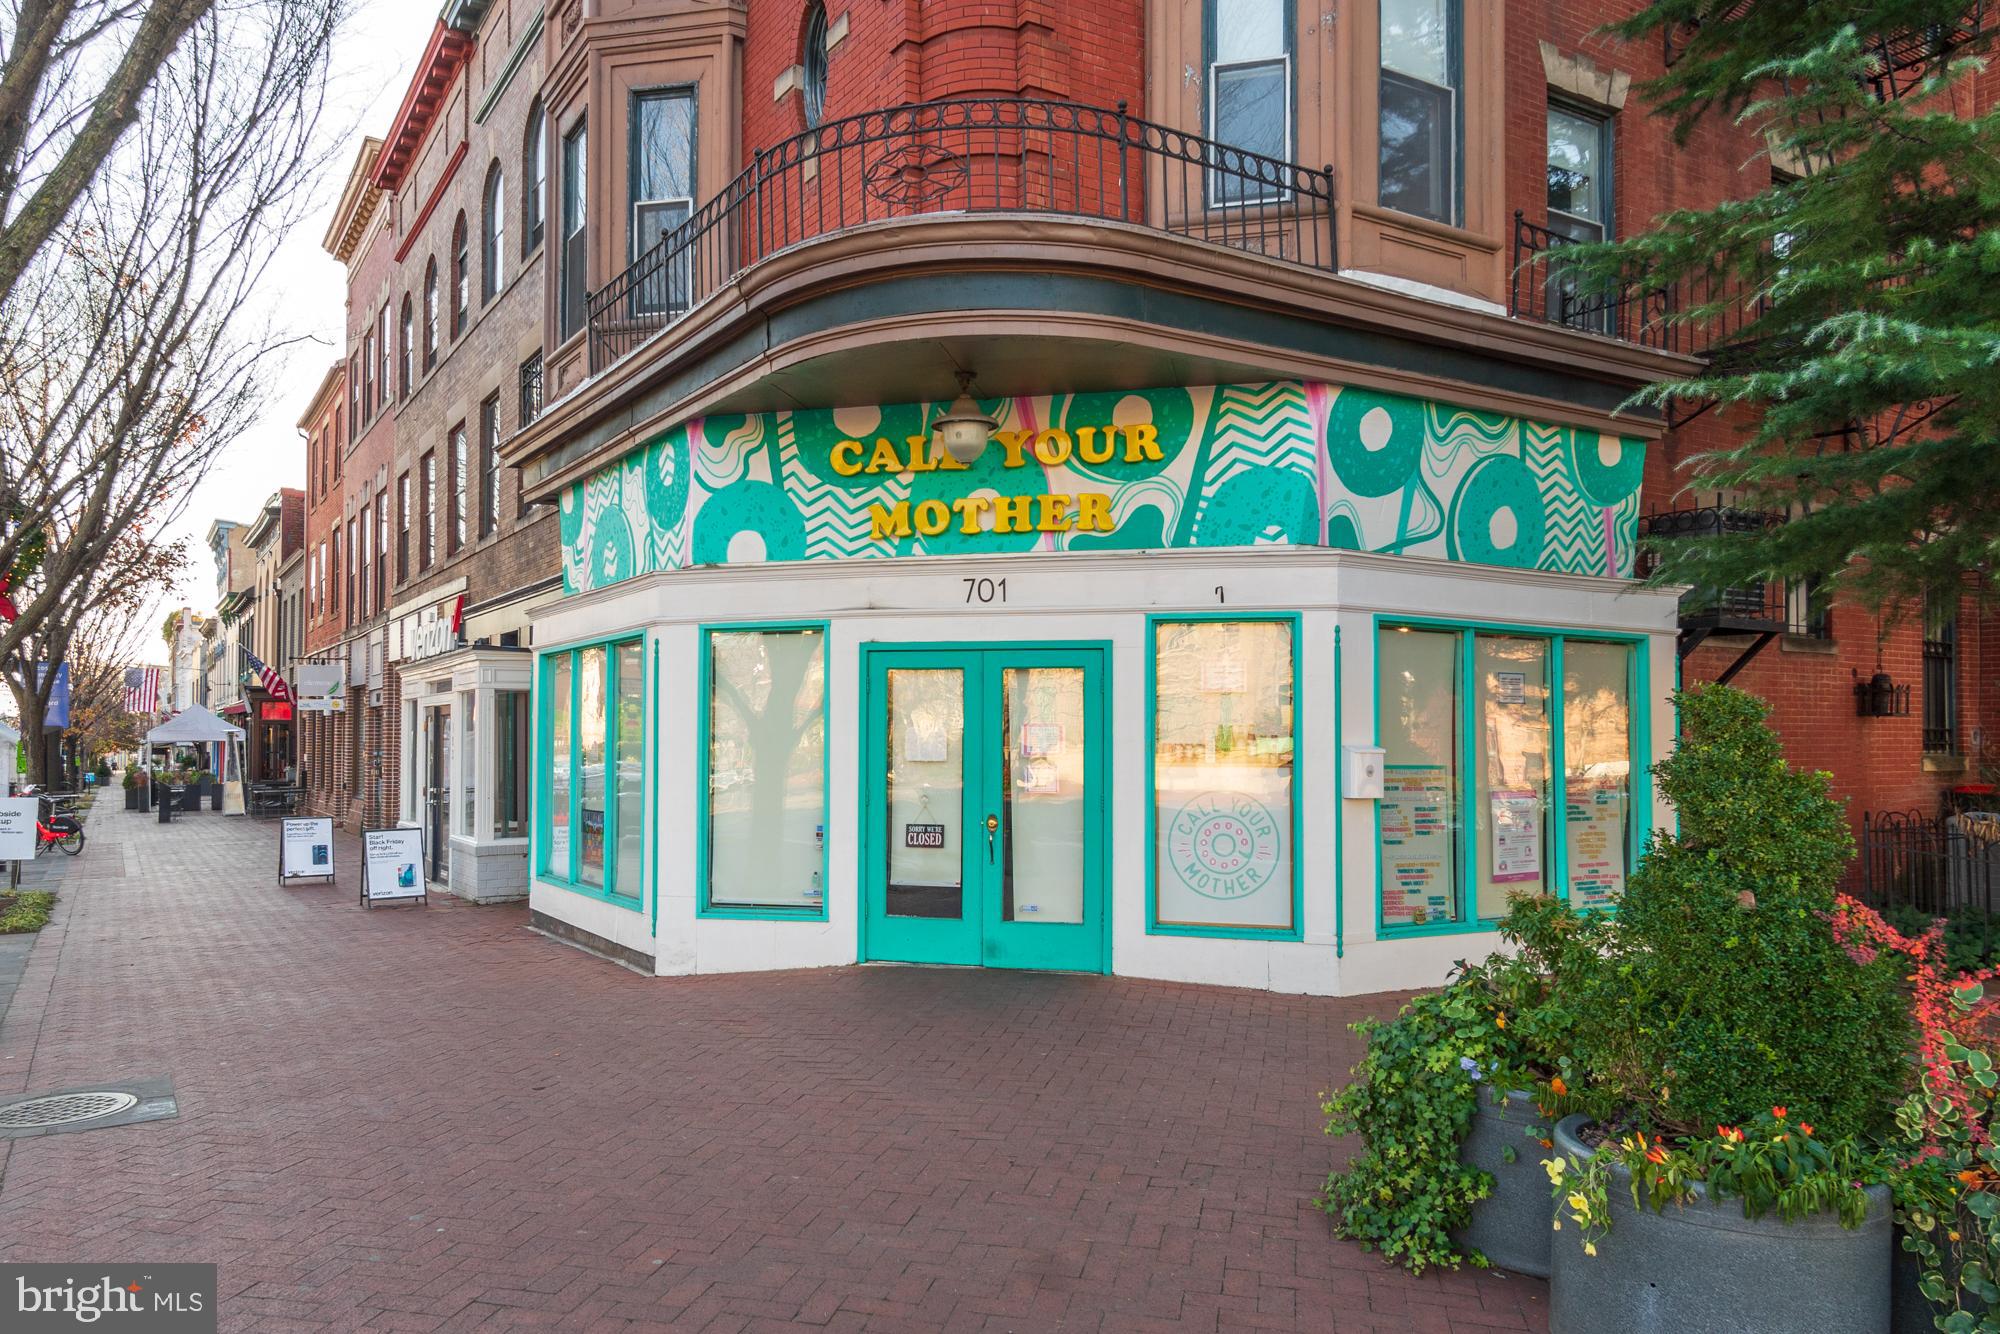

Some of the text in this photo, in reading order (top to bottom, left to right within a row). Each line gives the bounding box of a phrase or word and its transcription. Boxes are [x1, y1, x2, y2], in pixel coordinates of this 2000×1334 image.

[995, 424, 1165, 468] YOUR
[868, 493, 1116, 540] MOTHER
[963, 578, 1007, 603] 701
[410, 613, 456, 661] verizon
[1178, 797, 1272, 838] CALL YOUR
[907, 832, 942, 846] CLOSED
[1184, 862, 1262, 895] MOTHER
